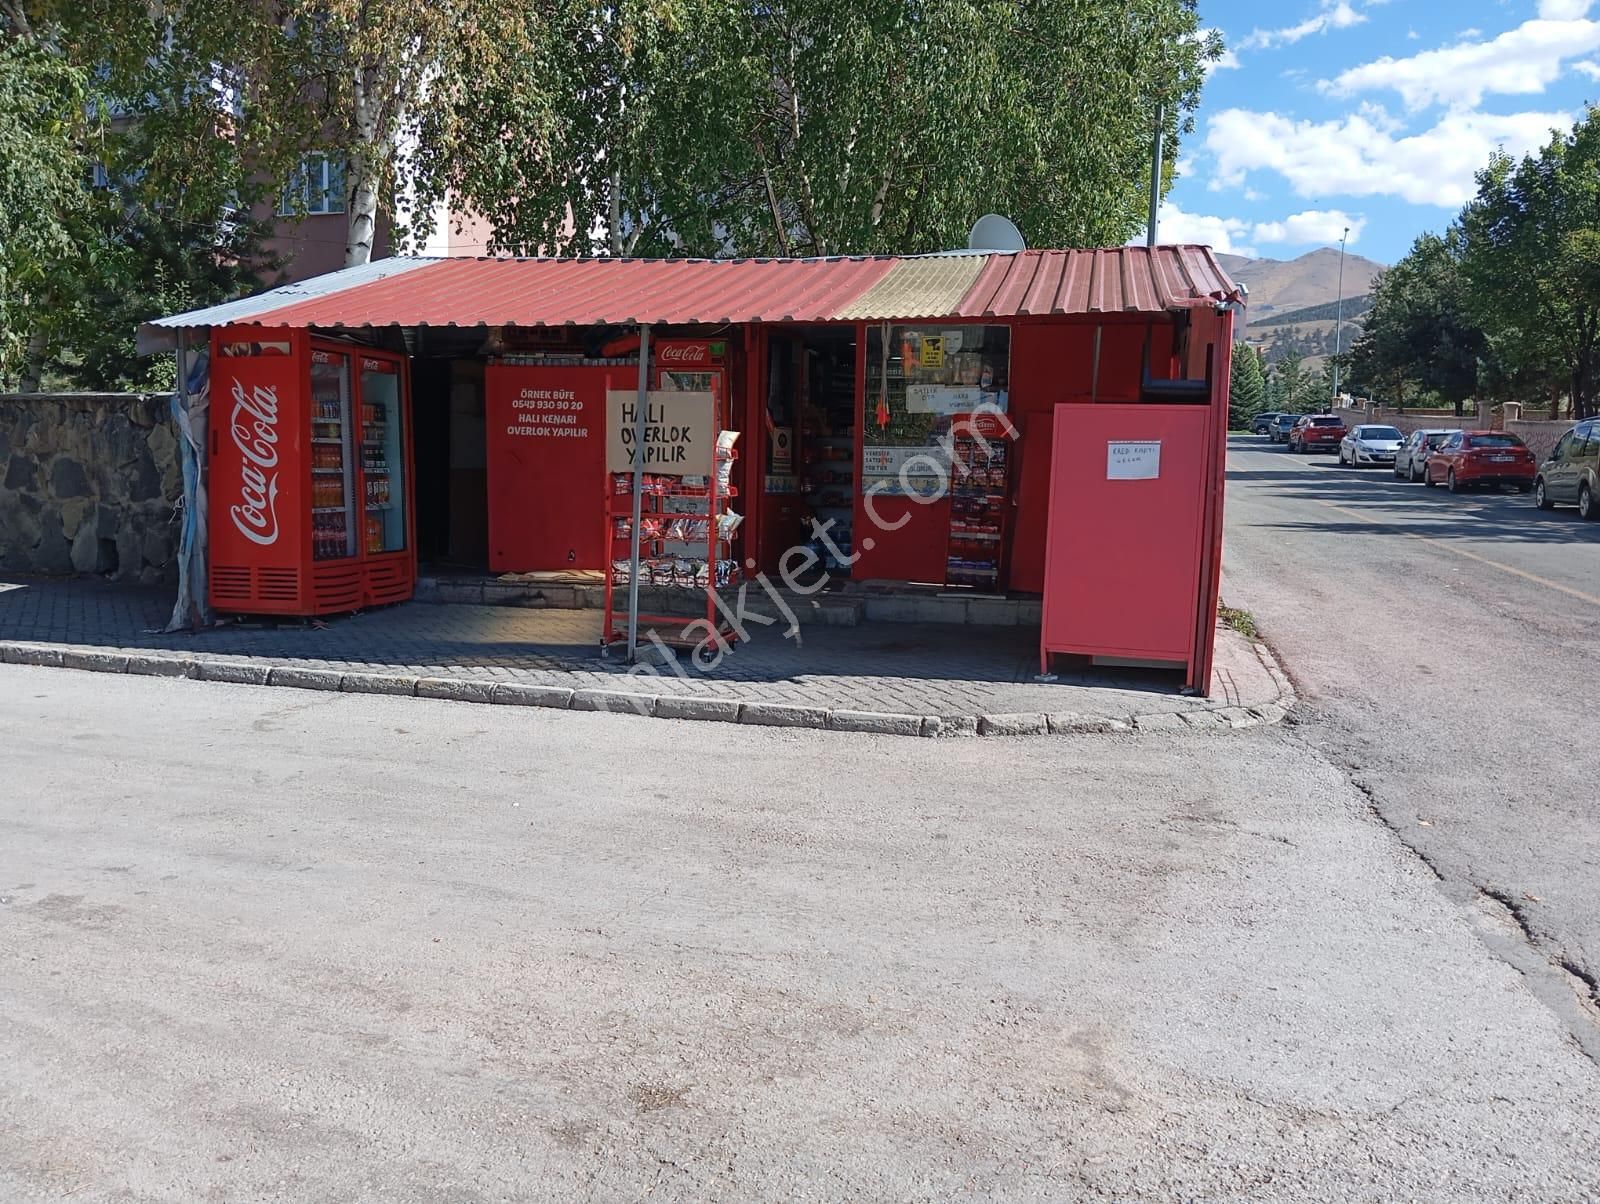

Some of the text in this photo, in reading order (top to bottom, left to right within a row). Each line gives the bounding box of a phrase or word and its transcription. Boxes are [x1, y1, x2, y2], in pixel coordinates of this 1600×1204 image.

[520, 388, 575, 400] ÖRNEK BÜFE
[537, 400, 555, 409] 930
[556, 401, 569, 410] 90
[570, 401, 583, 411] 20
[518, 413, 577, 425] HALI KENARI
[507, 426, 588, 438] OVERLOK YAPILIR
[230, 375, 278, 545] Coca-Cola
